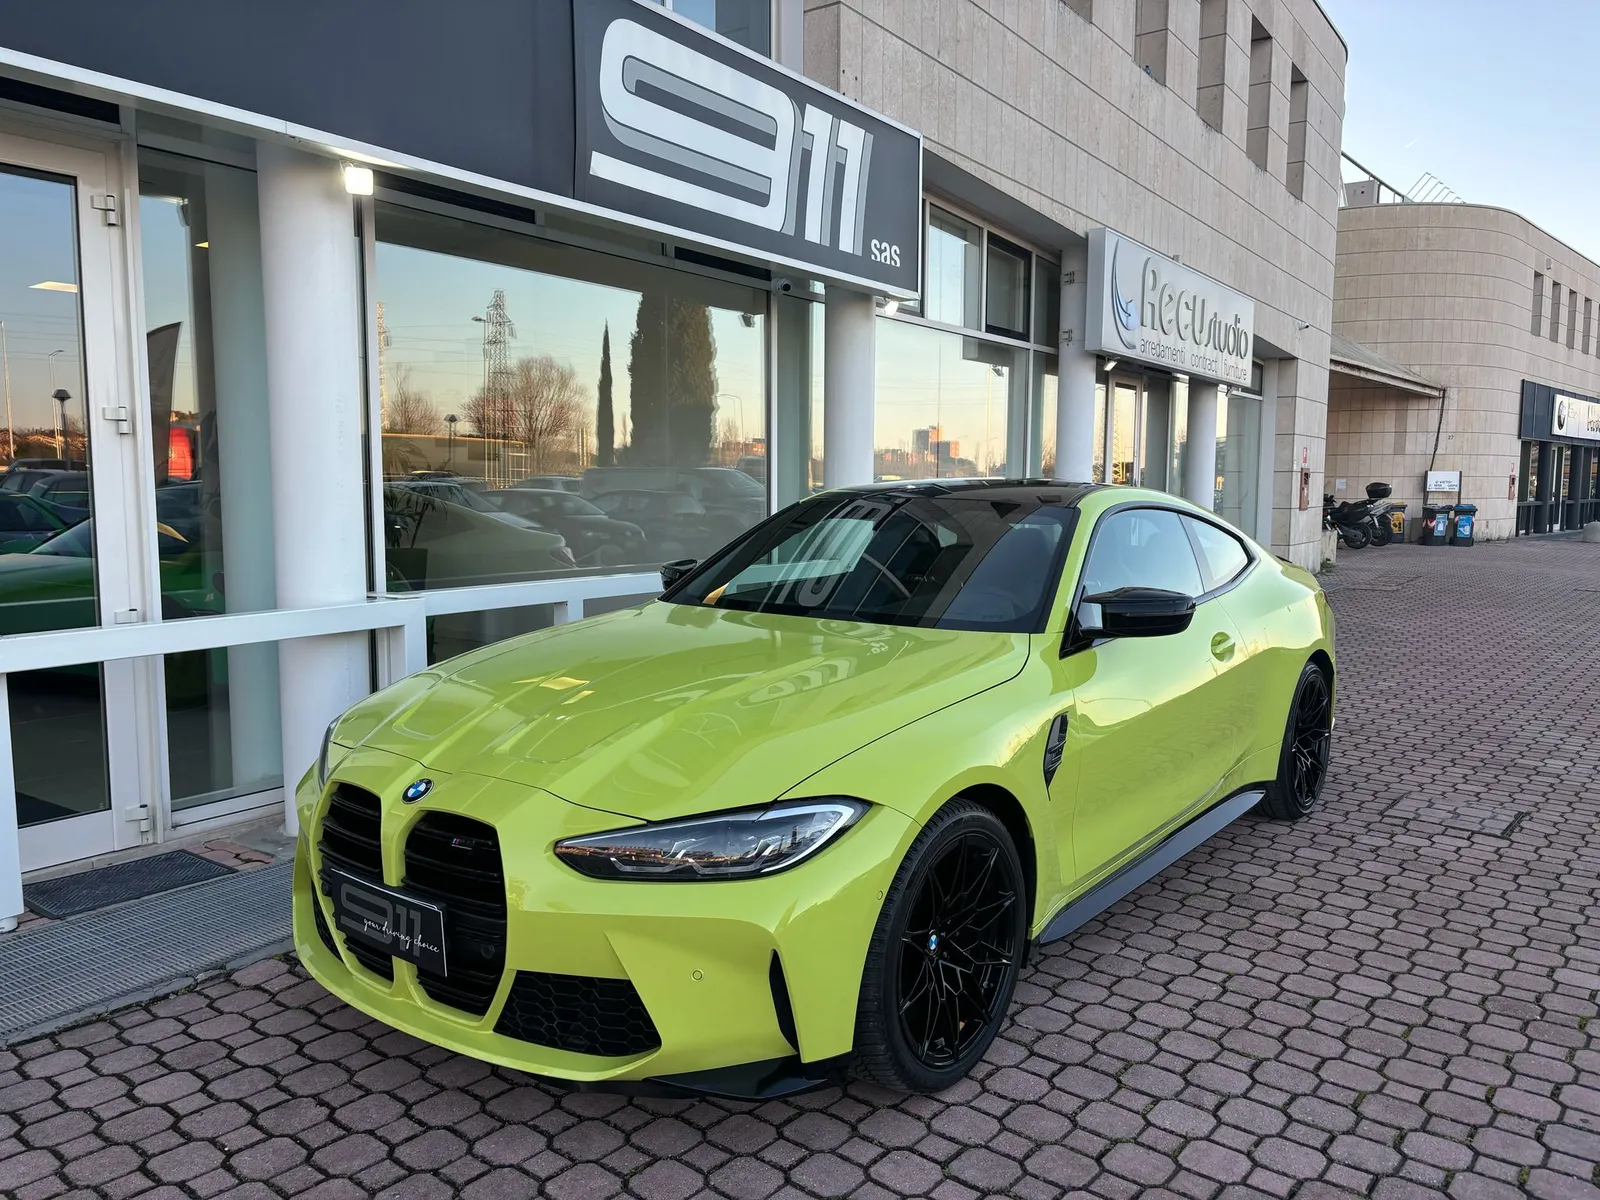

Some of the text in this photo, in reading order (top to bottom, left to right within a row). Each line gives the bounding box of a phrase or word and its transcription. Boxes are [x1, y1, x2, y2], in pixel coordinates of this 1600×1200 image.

[589, 18, 873, 256] 911
[870, 239, 900, 267] sas
[1140, 338, 1248, 382] arredamenti contract furniture
[340, 883, 421, 957] 911
[363, 918, 440, 953] your driving choice
